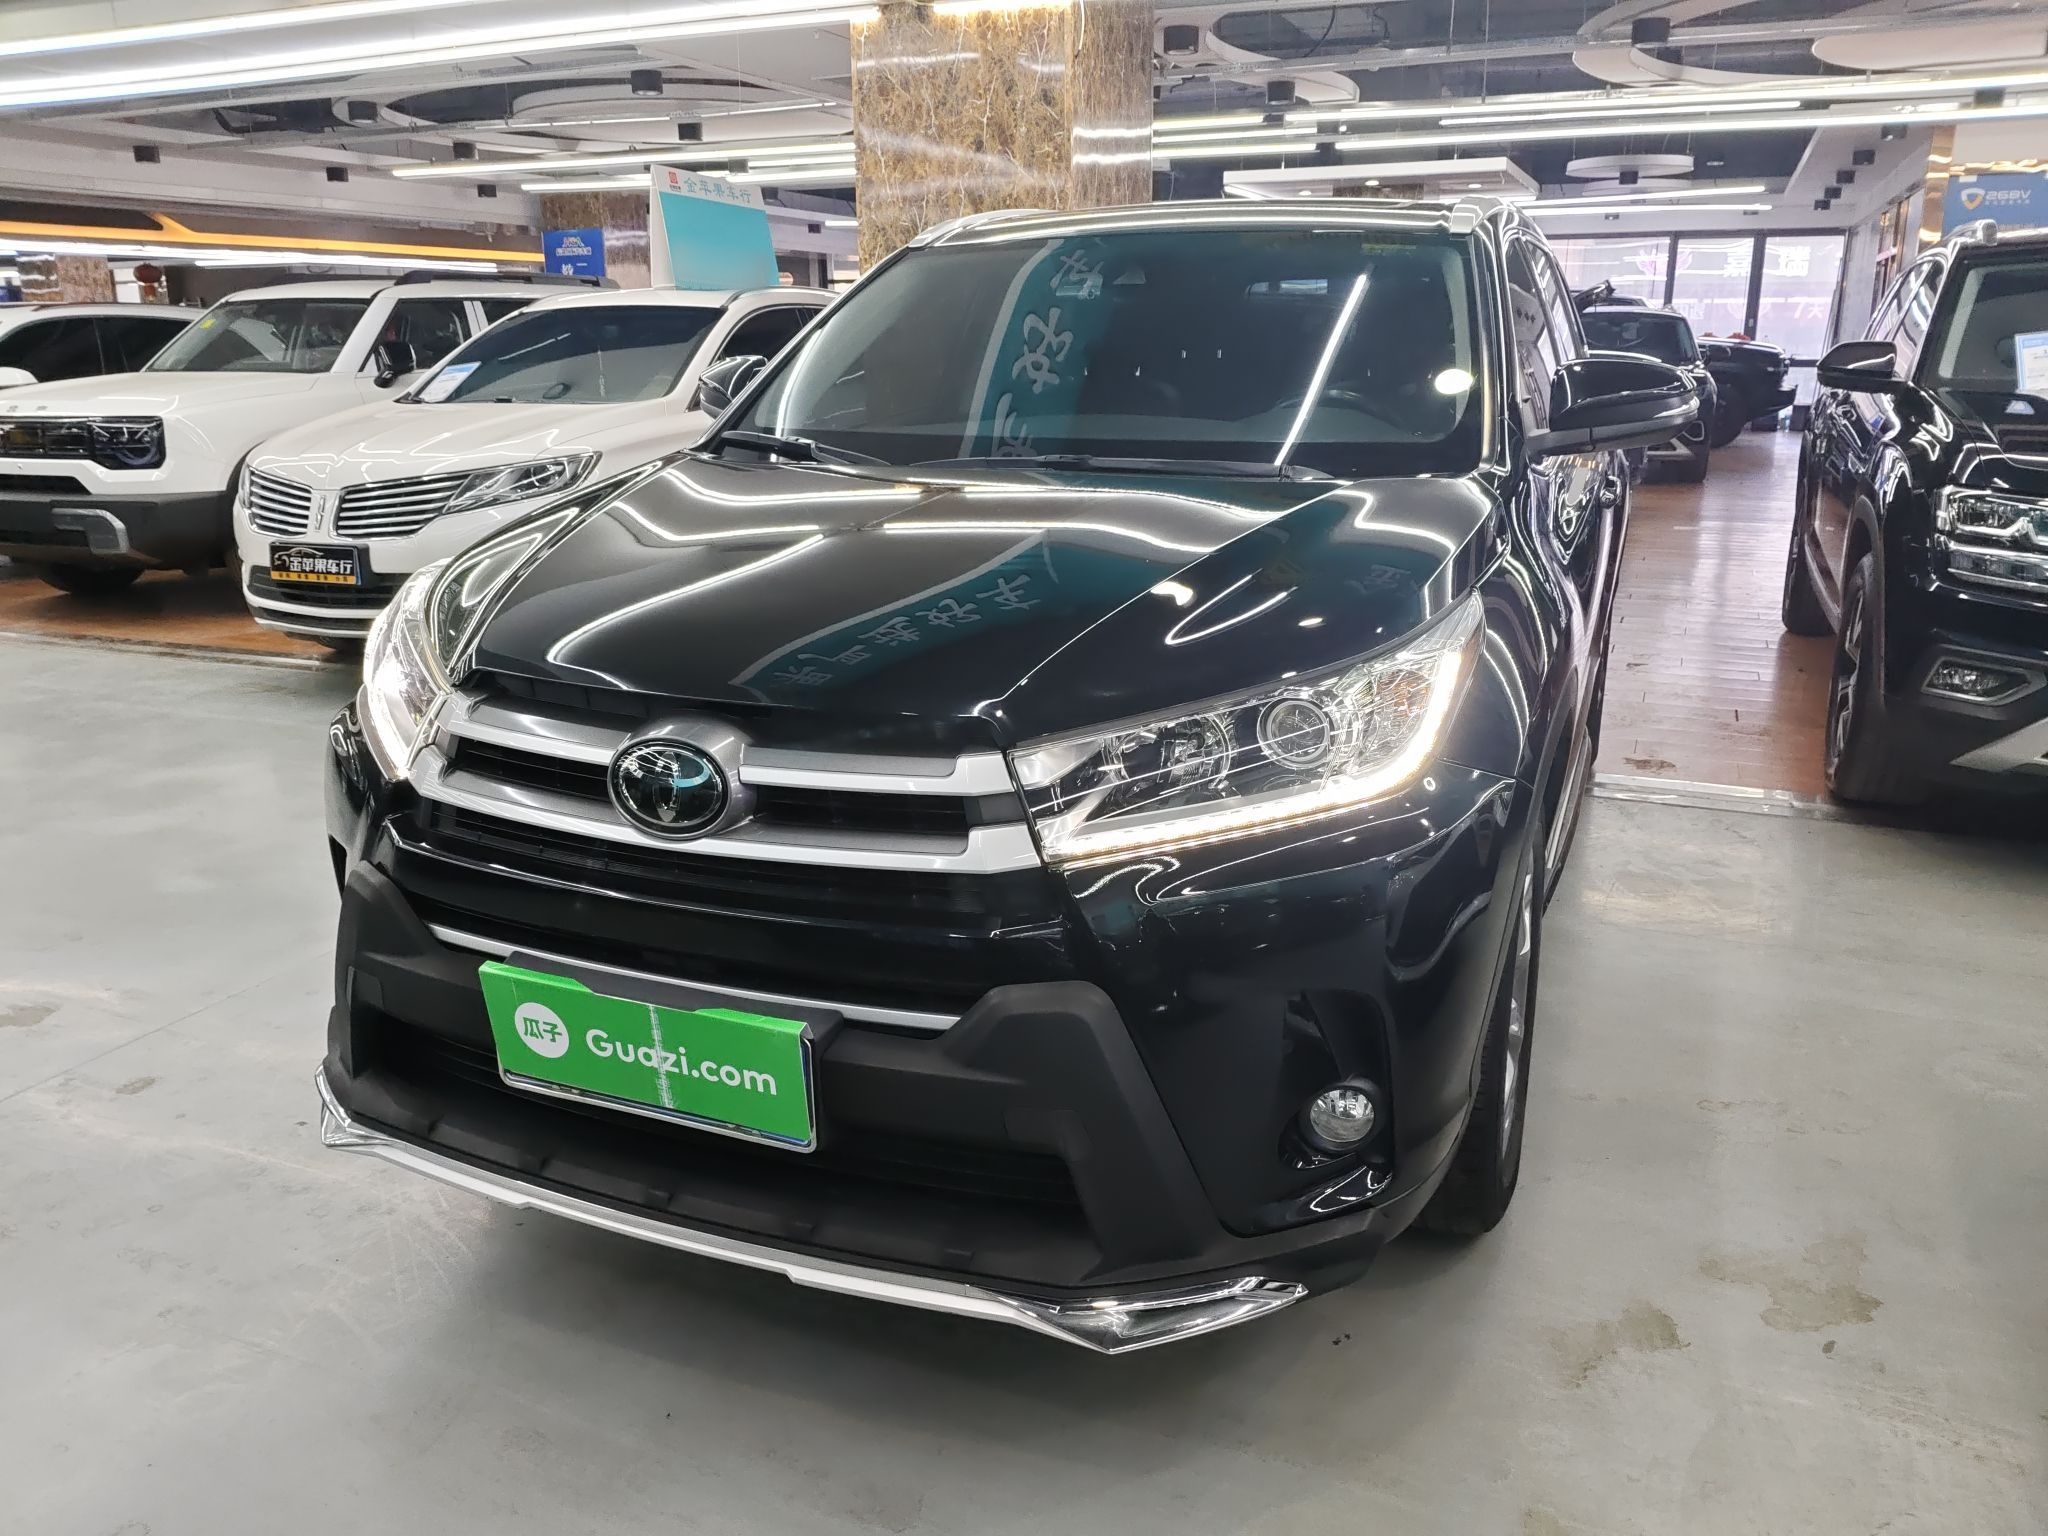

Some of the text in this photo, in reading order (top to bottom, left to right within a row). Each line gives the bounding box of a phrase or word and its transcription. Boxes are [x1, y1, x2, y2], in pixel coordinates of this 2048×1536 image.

[683, 177, 752, 204] 金苹果车行
[289, 556, 353, 575] 金苹果车行
[521, 1015, 563, 1044] 瓜子
[585, 1028, 778, 1096] Guazi.com
